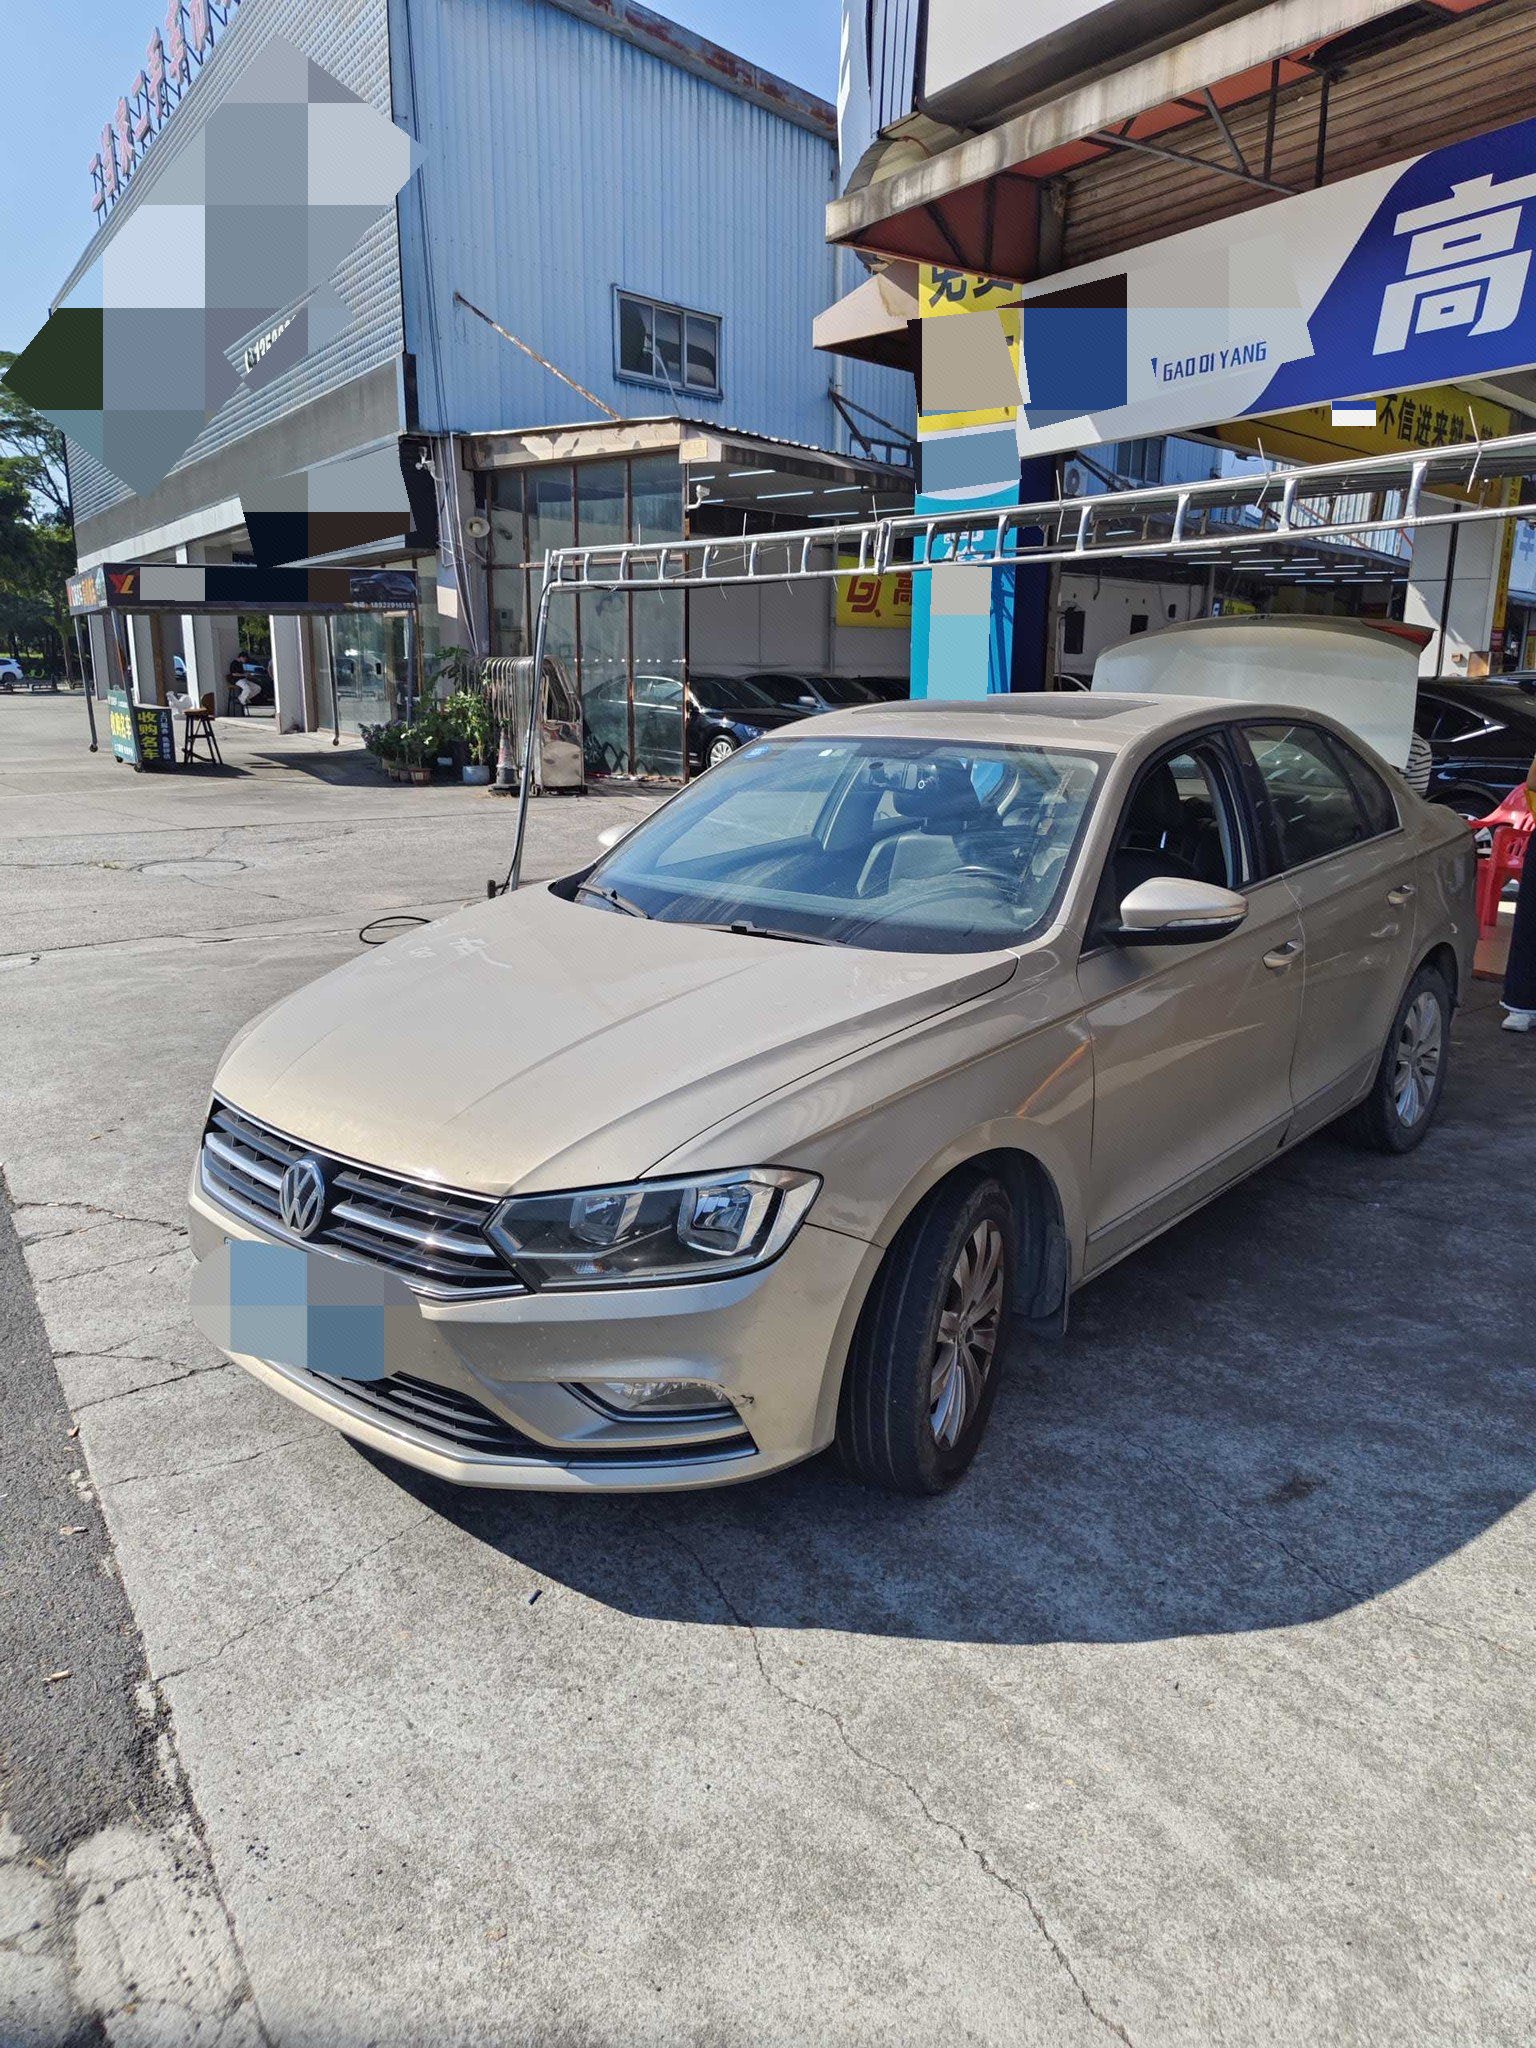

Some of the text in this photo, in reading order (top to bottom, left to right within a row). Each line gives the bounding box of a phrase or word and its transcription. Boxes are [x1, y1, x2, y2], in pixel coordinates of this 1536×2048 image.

[1373, 173, 1536, 355] 高
[137, 710, 160, 761] 收购名车
